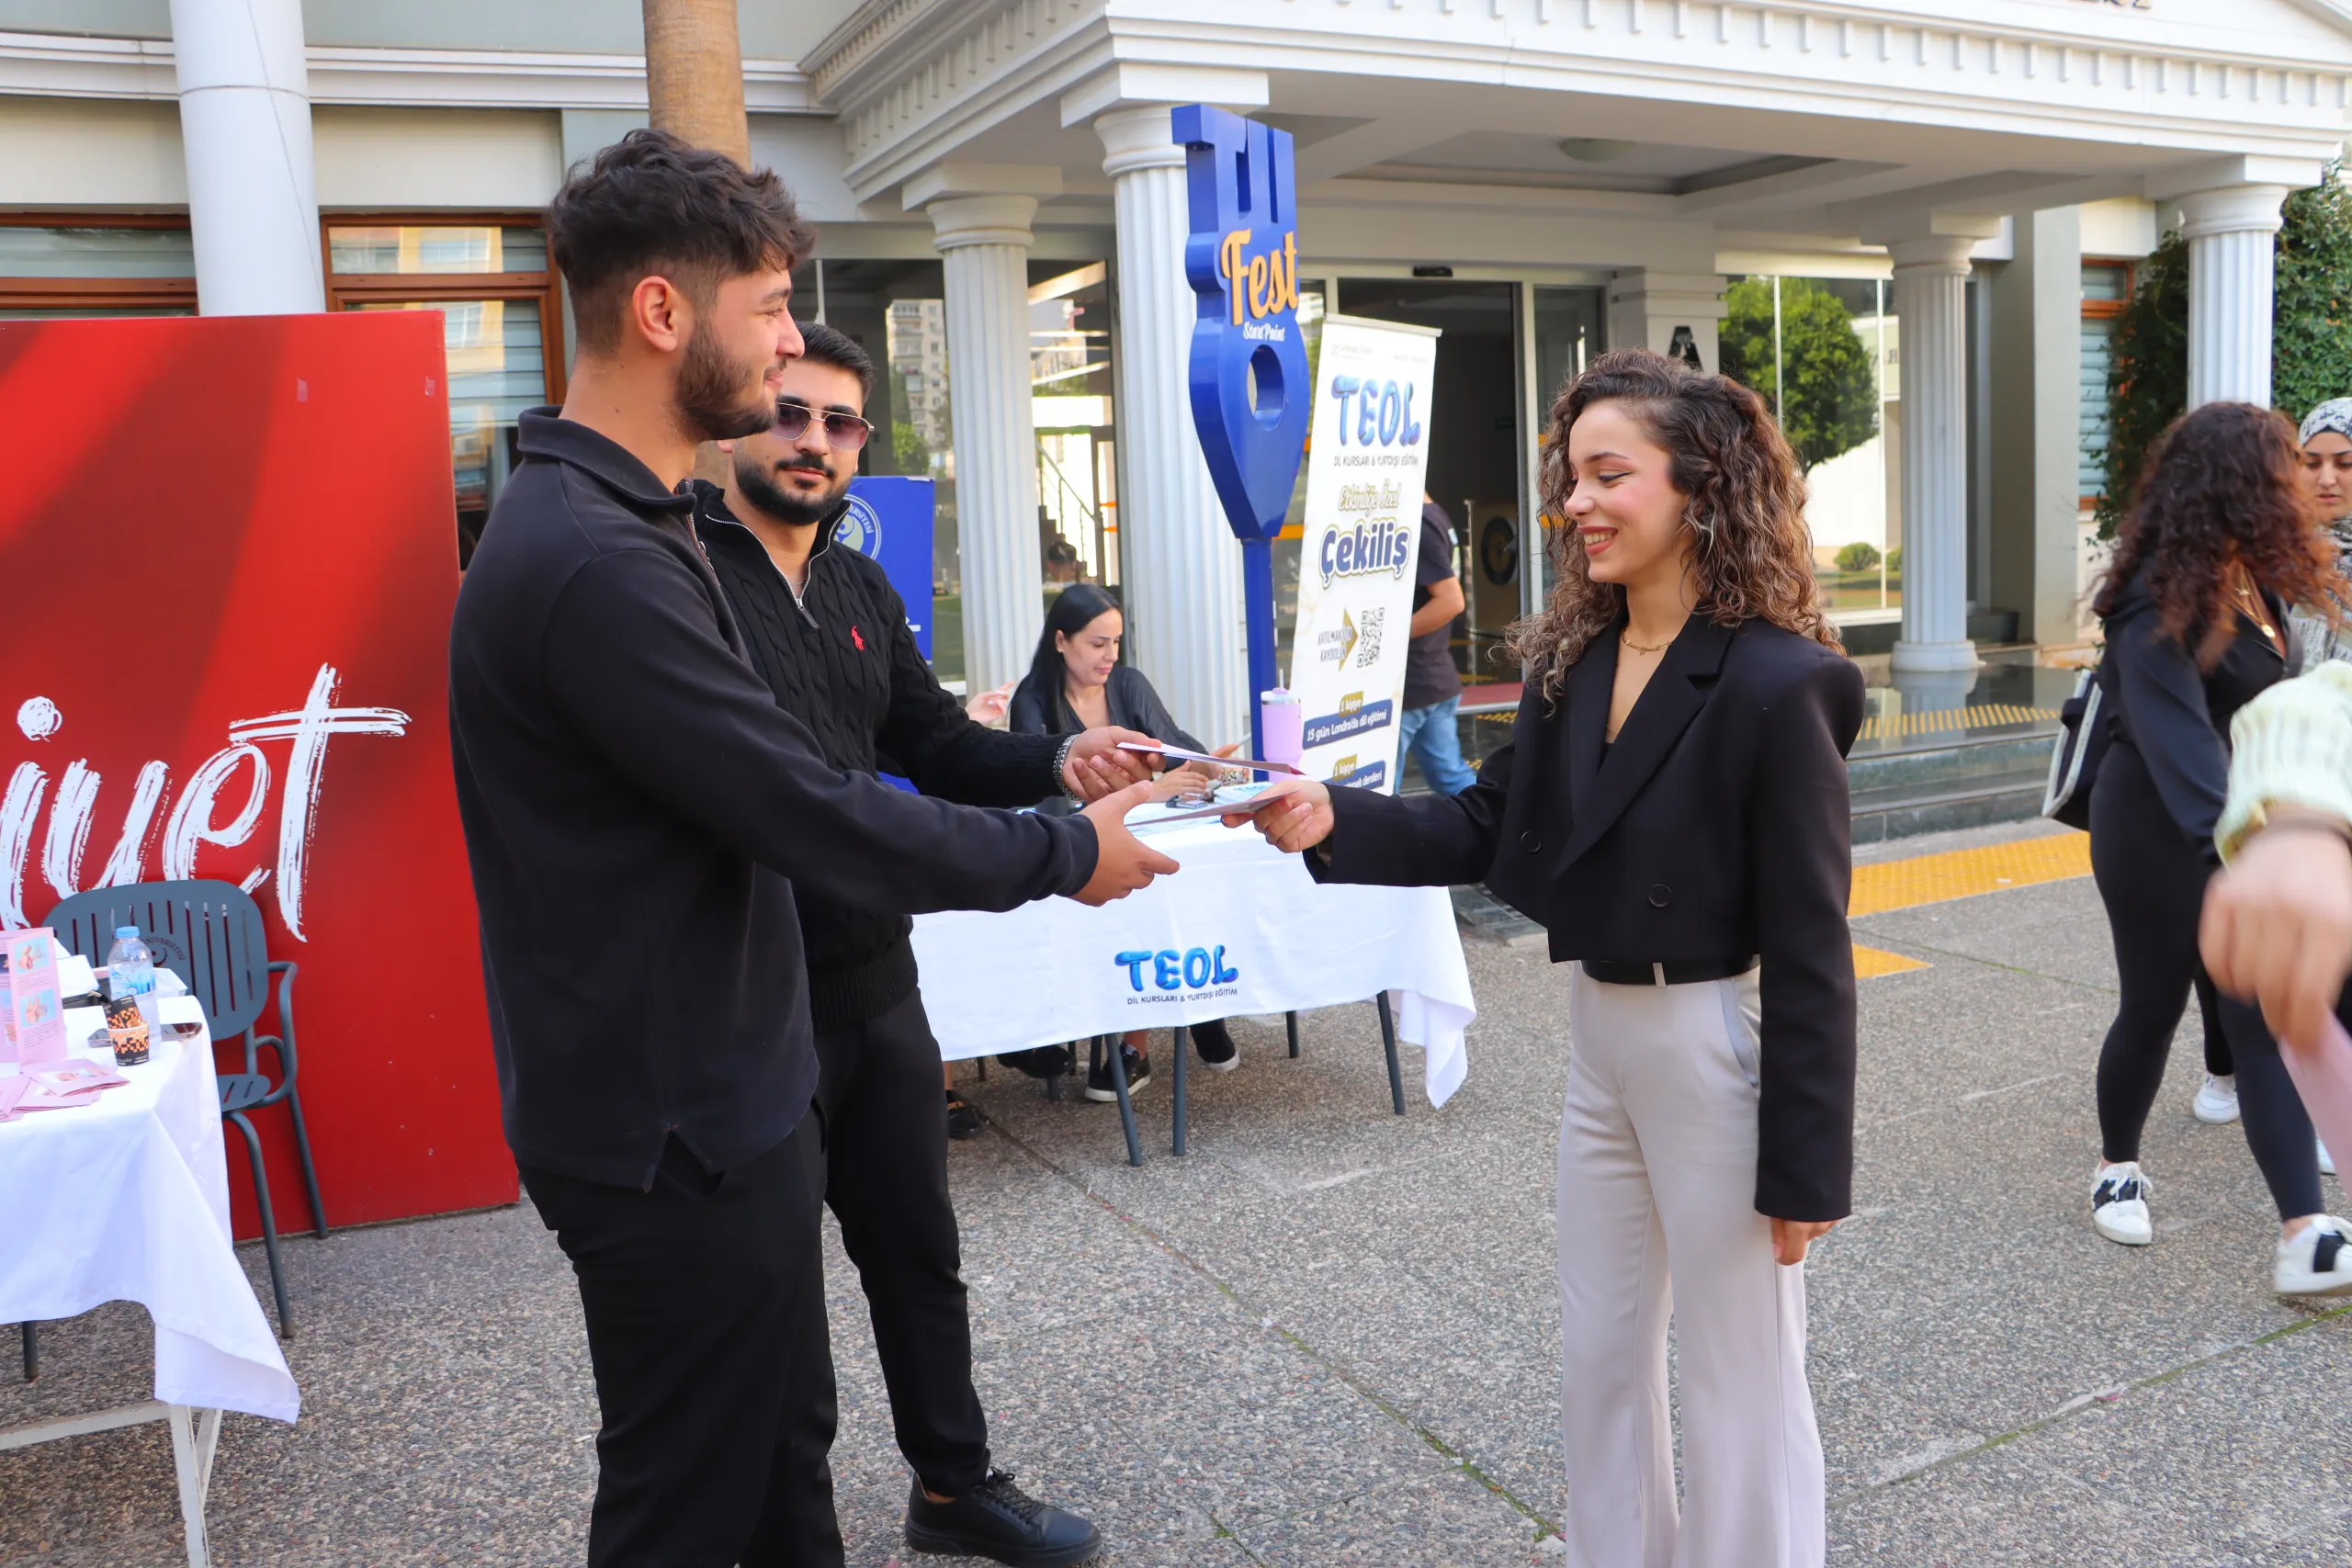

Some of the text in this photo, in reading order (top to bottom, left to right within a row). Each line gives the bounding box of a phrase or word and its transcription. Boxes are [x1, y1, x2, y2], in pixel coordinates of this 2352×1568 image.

[1221, 228, 1299, 326] Fest
[1243, 321, 1285, 342] Start Point
[1331, 374, 1421, 447] TEOL
[1343, 454, 1369, 467] KURSLARI
[1320, 521, 1409, 584] Çekiliş
[1307, 728, 1315, 741] 15
[1316, 726, 1329, 742] gün
[1368, 709, 1387, 726] eğitimi
[1114, 944, 1238, 992] TEOL
[1127, 997, 1139, 1005] DİL
[1141, 995, 1178, 1003] KURSLARI
[1187, 991, 1214, 1002] YURTDIŞI
[1216, 987, 1238, 998] EĞİTİM
